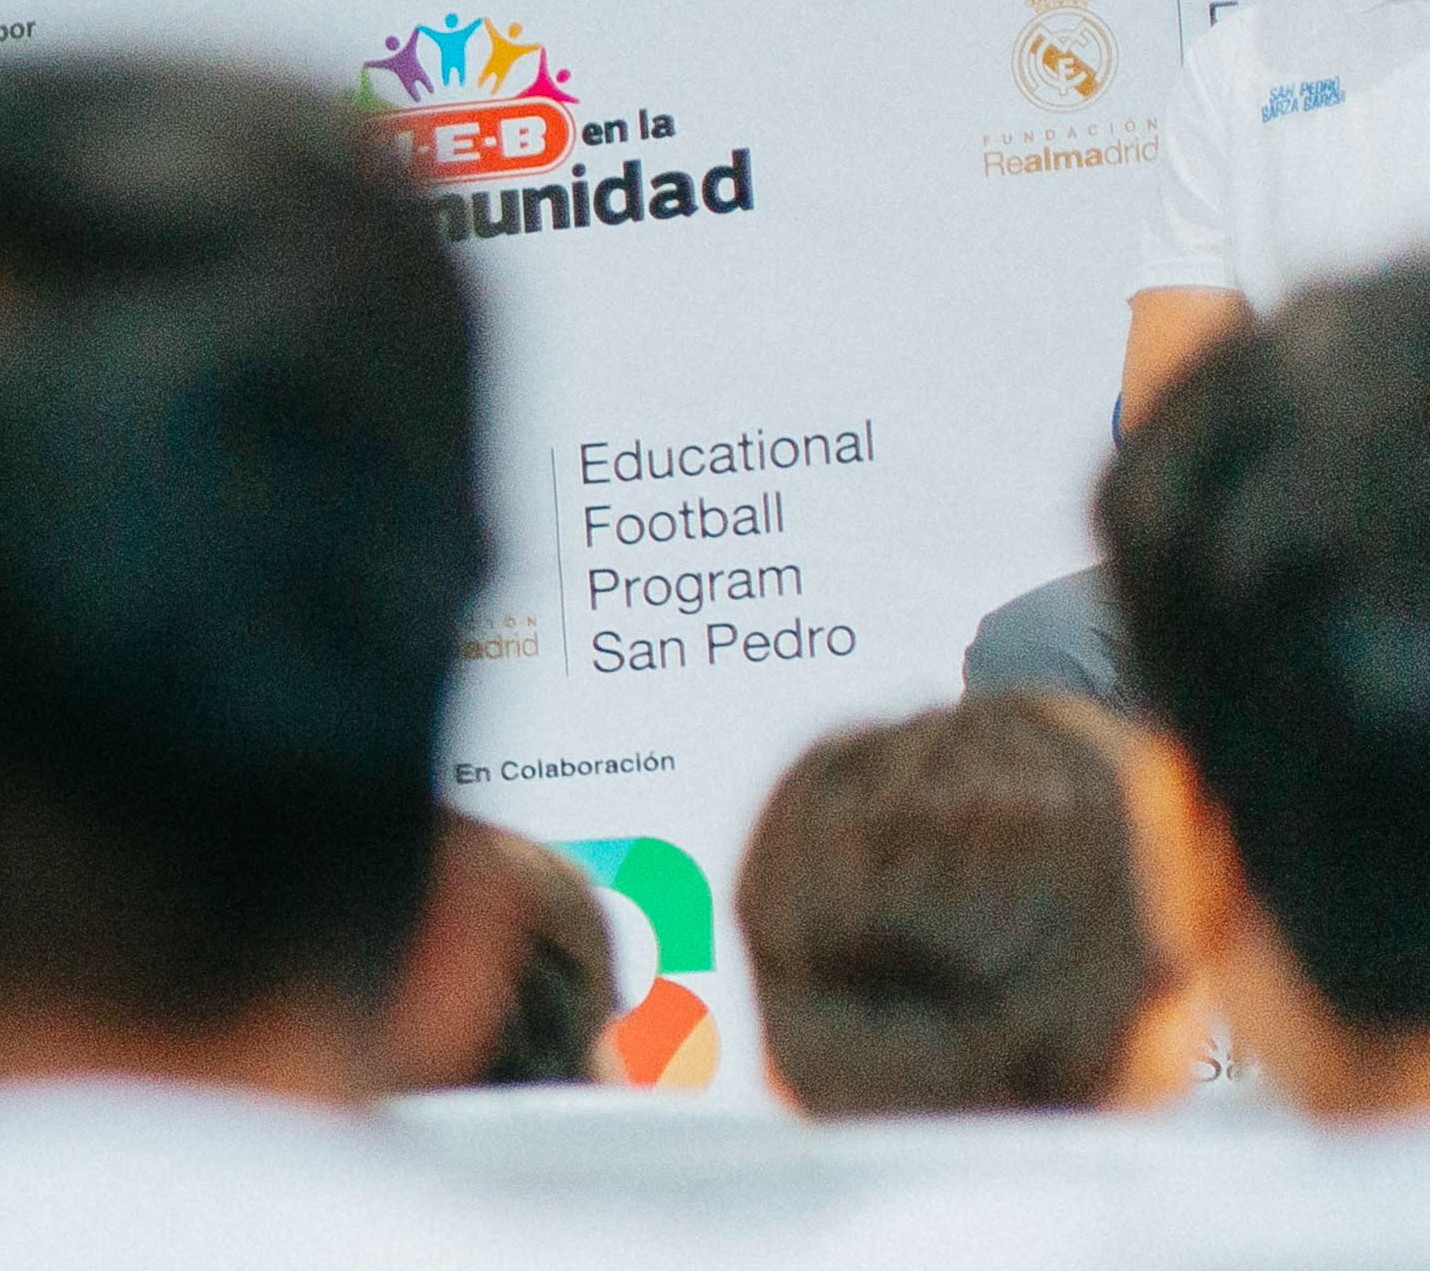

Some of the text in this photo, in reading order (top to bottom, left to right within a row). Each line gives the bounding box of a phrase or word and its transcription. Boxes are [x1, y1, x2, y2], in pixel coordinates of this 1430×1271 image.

[582, 118, 629, 146] en
[639, 108, 677, 140] la
[433, 147, 755, 239] unidad
[580, 419, 875, 485] Educational
[584, 490, 784, 548] Football
[588, 564, 802, 615] Program
[592, 617, 857, 674] San Pedro
[456, 750, 677, 784] En Colaboración
